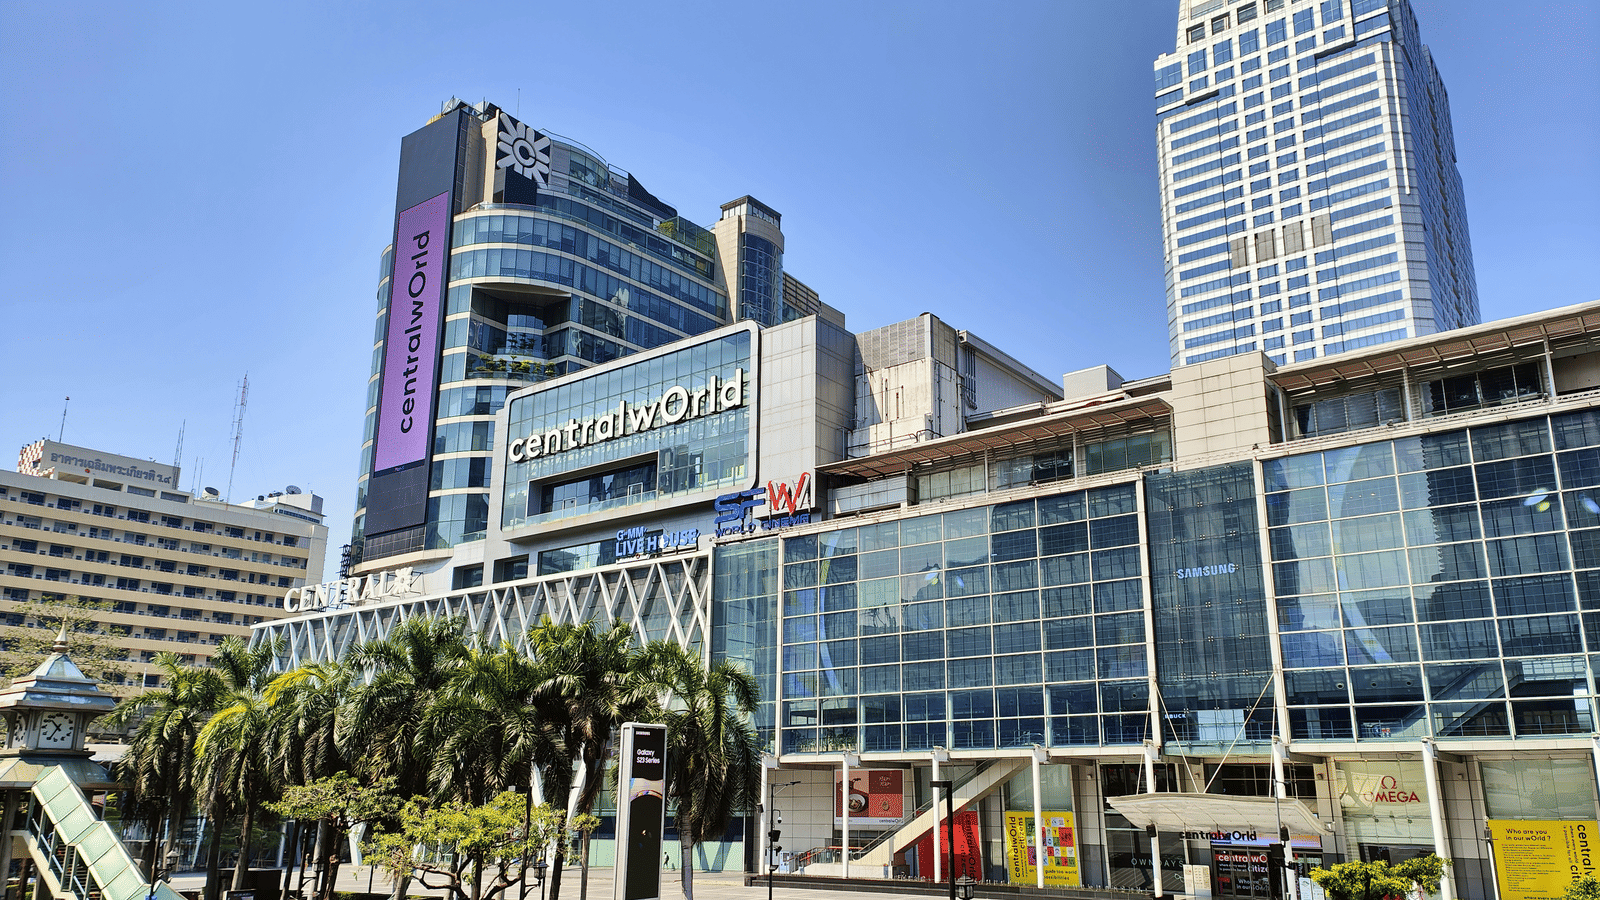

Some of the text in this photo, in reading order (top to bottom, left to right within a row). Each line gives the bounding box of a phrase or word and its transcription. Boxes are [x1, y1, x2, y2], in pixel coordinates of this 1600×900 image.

[400, 230, 430, 434] centralwOrld
[508, 368, 744, 463] centralwOrld
[714, 513, 811, 538] WORLD CINEMA
[615, 538, 645, 556] LIVE
[1176, 562, 1236, 579] SAMSUNG
[284, 571, 394, 612] CENTRAL
[636, 748, 655, 757] Galaxy
[1364, 791, 1420, 802] OMEGA
[1009, 816, 1020, 878] centralwOrld
